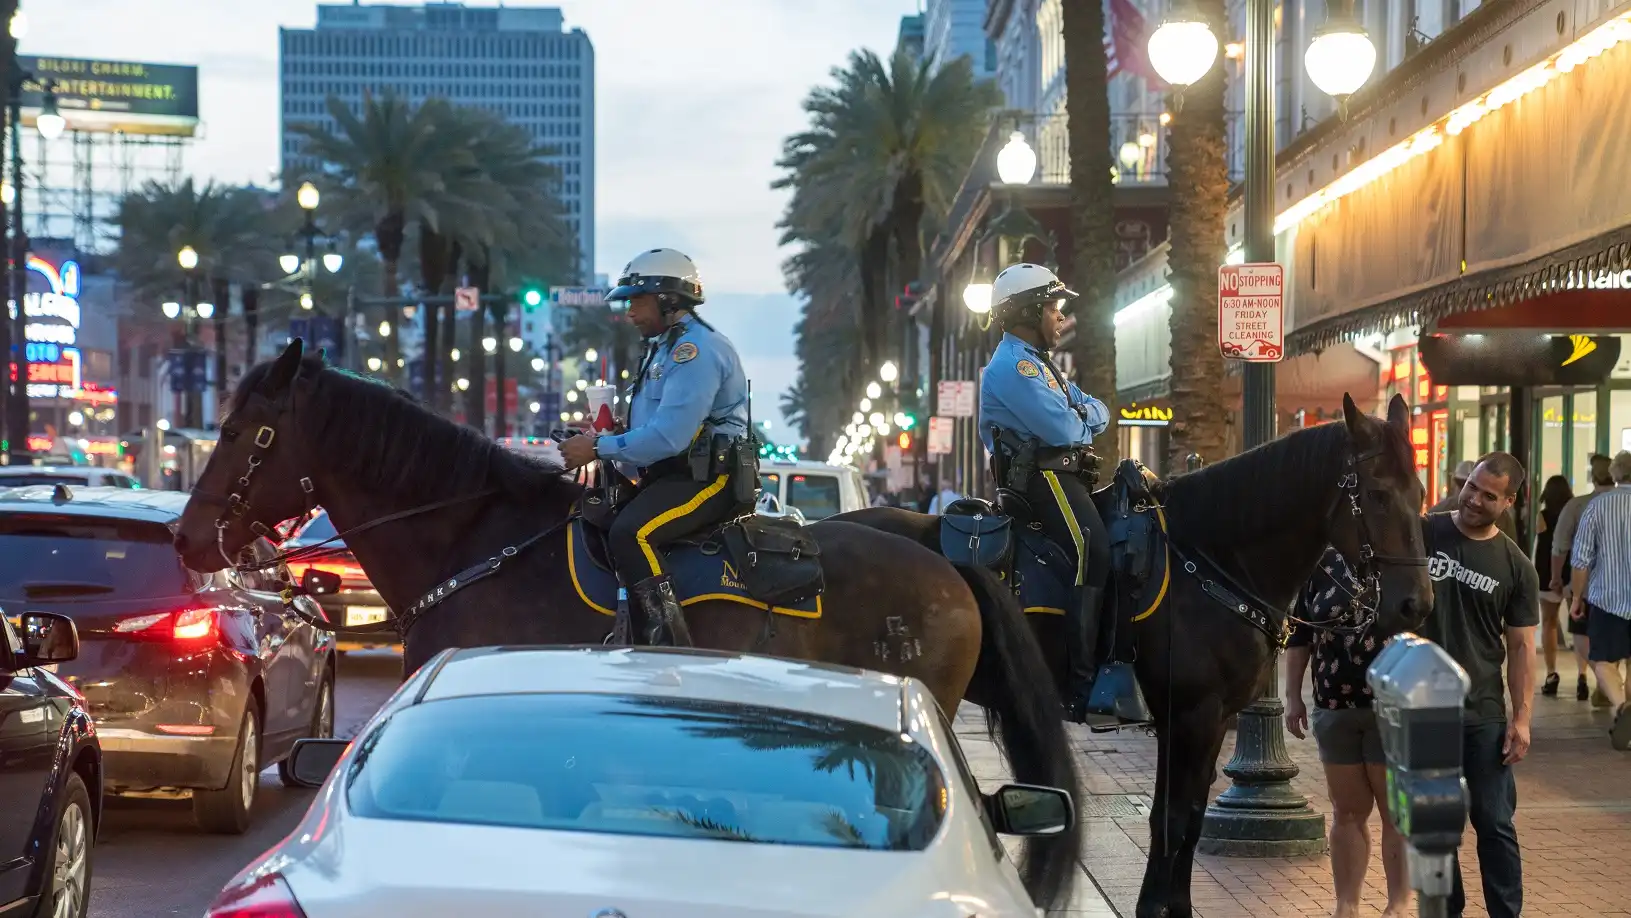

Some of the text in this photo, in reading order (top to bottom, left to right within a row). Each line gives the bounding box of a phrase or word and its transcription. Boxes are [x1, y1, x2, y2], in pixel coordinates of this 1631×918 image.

[1221, 273, 1281, 291] NO STOPPING
[1223, 299, 1279, 308] 6:30 AM-NOON
[1234, 310, 1268, 319] FRIDAY
[1235, 321, 1267, 330] STREET
[1229, 331, 1274, 340] CLEANING
[1428, 557, 1499, 594] CF Bangor
[721, 575, 748, 590] Moun
[410, 587, 444, 615] TANK
